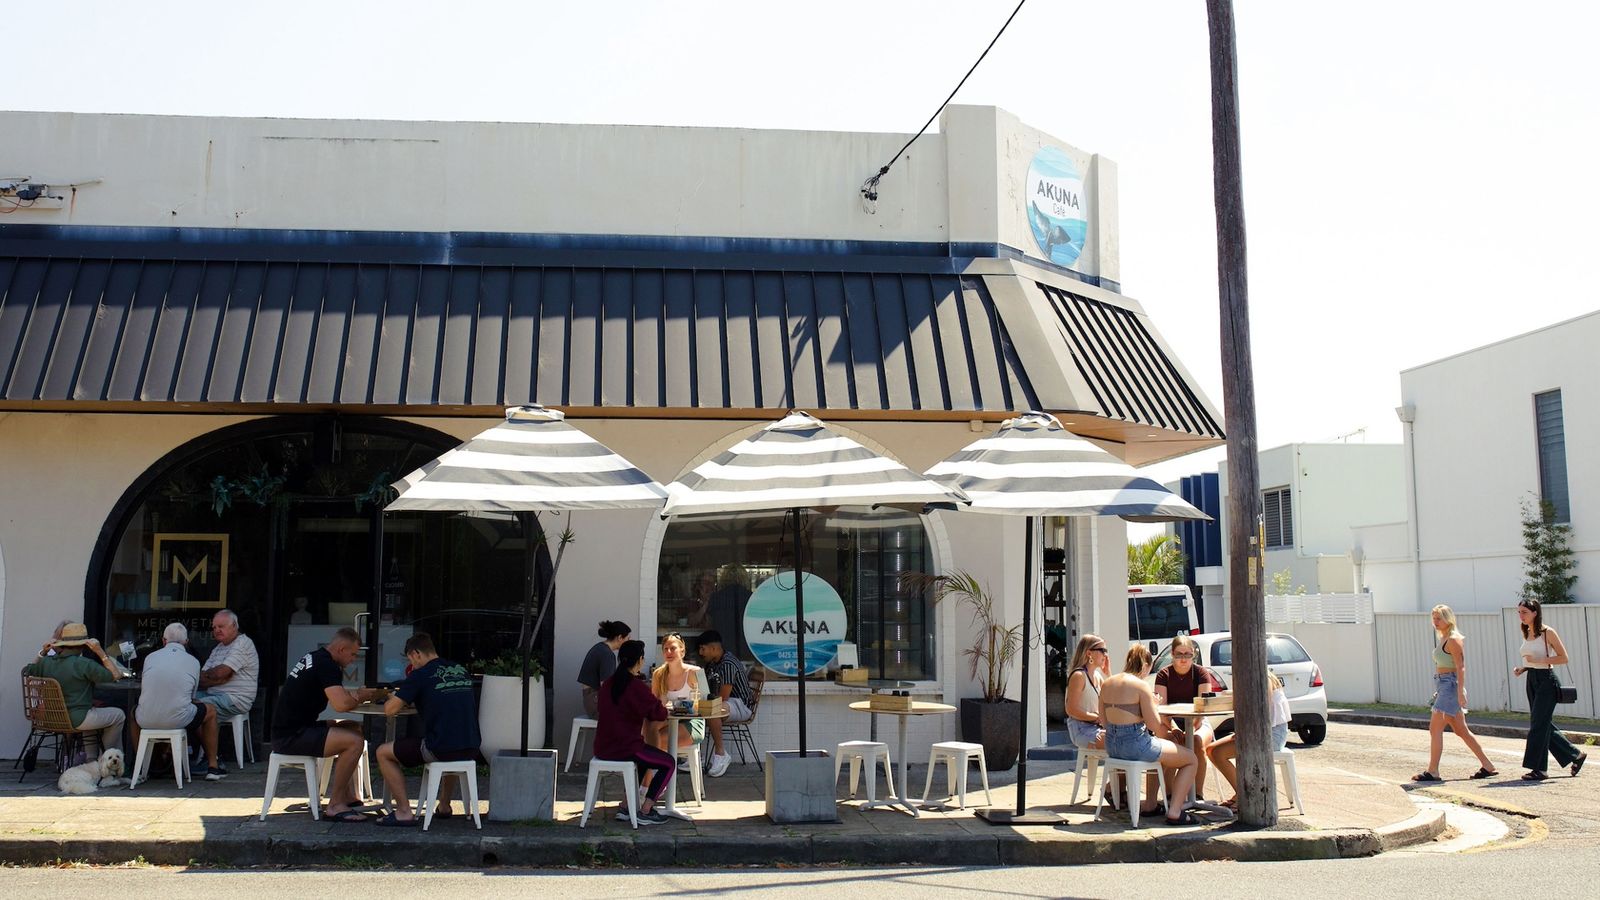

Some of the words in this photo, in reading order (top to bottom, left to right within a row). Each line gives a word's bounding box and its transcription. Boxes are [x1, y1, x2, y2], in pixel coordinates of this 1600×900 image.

[1037, 179, 1079, 210] AKUNA
[172, 553, 208, 584] M
[761, 620, 830, 634] AKUNA
